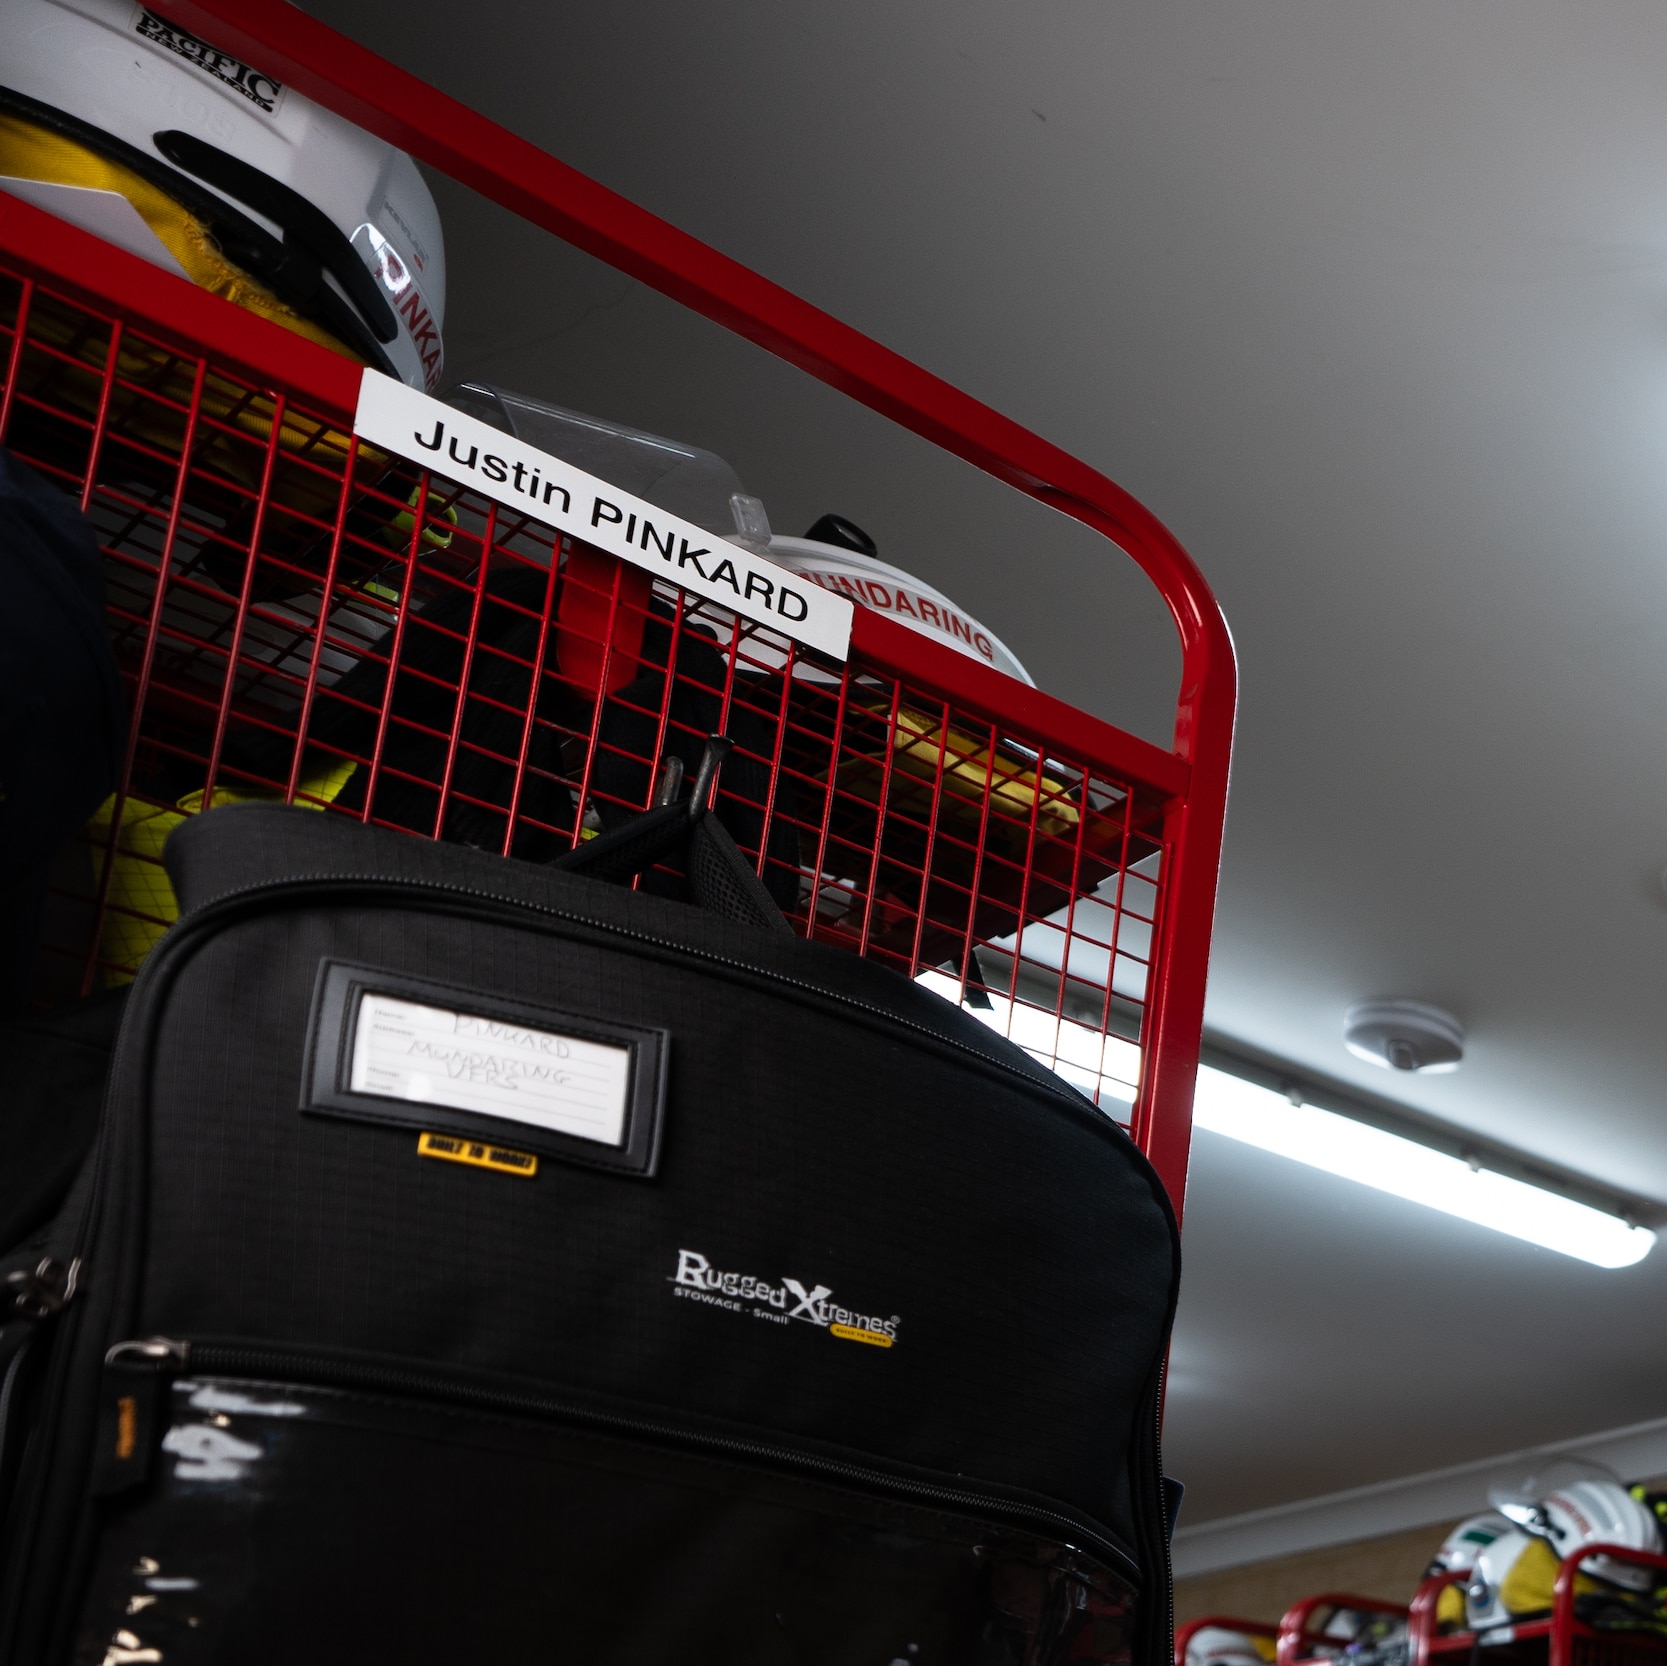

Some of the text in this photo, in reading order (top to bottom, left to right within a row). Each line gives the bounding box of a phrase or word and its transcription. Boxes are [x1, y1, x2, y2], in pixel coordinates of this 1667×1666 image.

[139, 12, 280, 104] PACIFIC
[189, 56, 265, 107] ZEALAND
[414, 421, 809, 623] Justin PINKARD
[673, 1286, 742, 1313] STOWAGE
[753, 1307, 790, 1326] Small
[676, 1249, 788, 1310] Rugged
